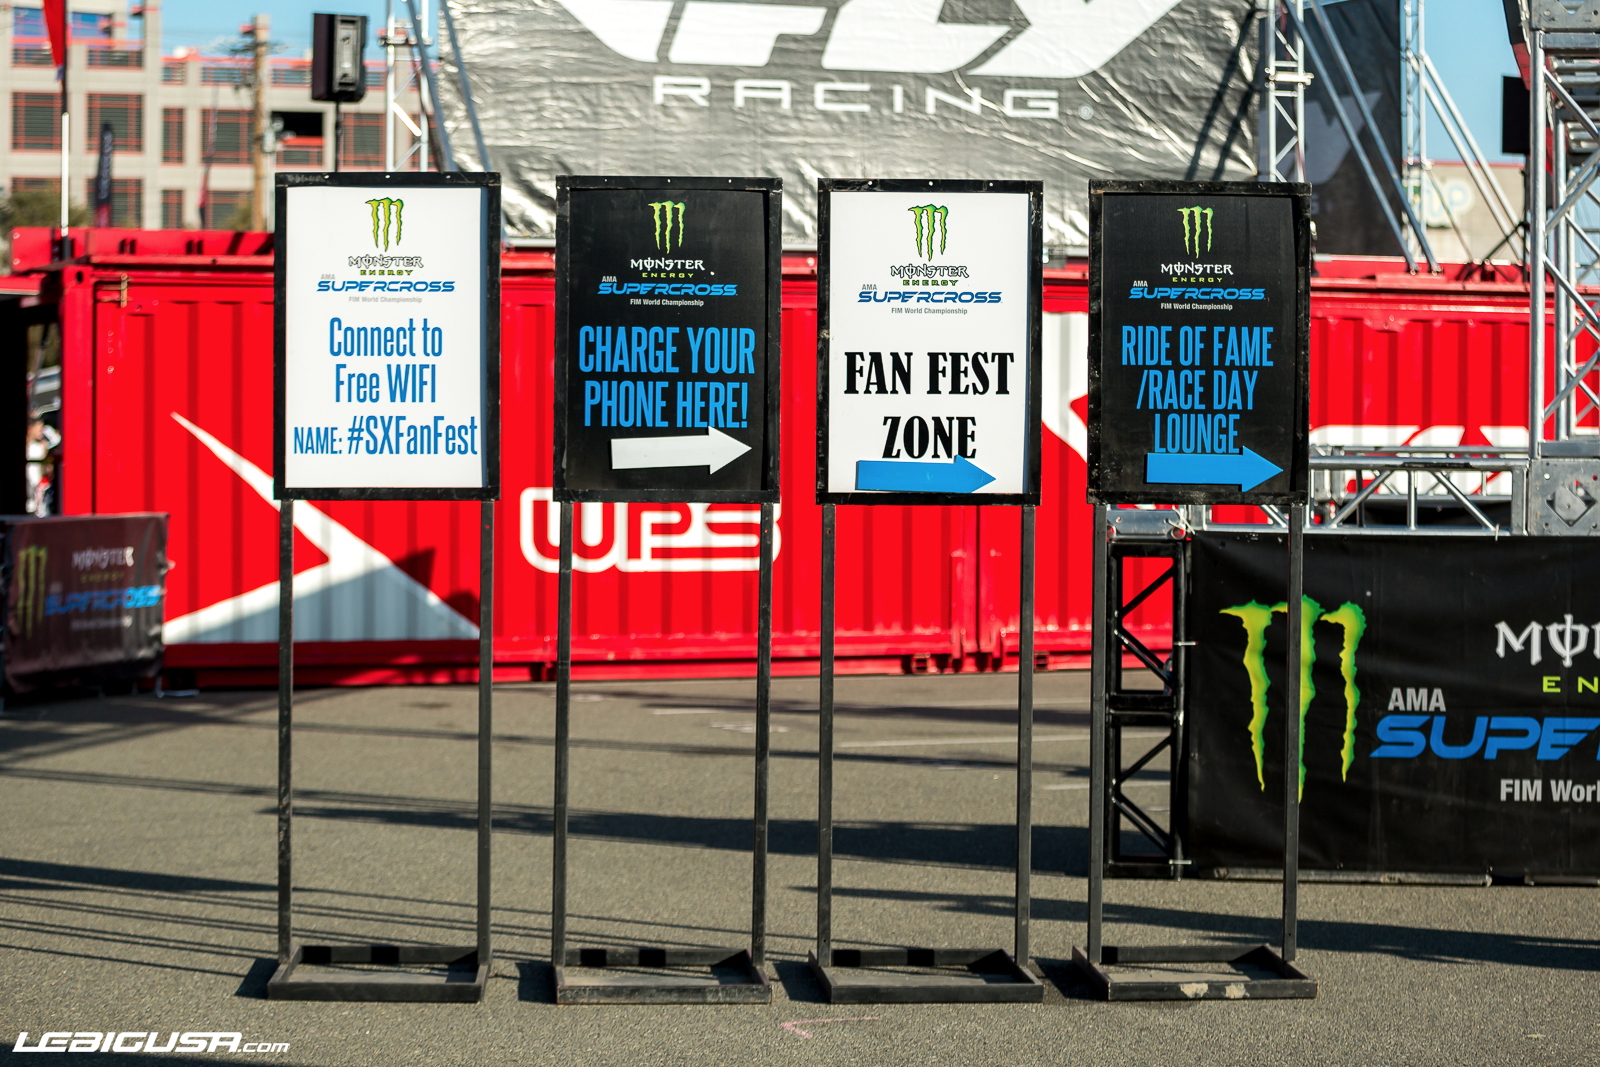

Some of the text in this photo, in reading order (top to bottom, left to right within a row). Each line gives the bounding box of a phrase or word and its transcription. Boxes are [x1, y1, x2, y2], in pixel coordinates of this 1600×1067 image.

[652, 75, 1060, 119] RACING
[348, 254, 424, 269] MONSTER
[630, 257, 705, 271] MONSTER
[890, 263, 970, 279] MONSTER
[1160, 261, 1234, 276] MONSTER
[316, 280, 456, 292] SUPERCROSS
[597, 282, 738, 296] SUPERCROSS
[601, 275, 617, 283] AMA
[380, 296, 423, 304] Championship
[661, 298, 704, 307] Championship
[857, 291, 1002, 304] SUPERCROSS
[1128, 287, 1266, 300] SUPERCROSS
[924, 307, 968, 315] Championship
[1191, 303, 1233, 311] Championship
[329, 317, 443, 357] Connect to
[1121, 325, 1274, 367] RIDE OF FAME
[578, 325, 756, 374] CHARGE YOUR
[335, 363, 437, 403] Free WIFI
[844, 351, 1015, 396] FAN FEST
[1136, 369, 1258, 410] /RACE DAY
[584, 380, 748, 428] PHONE HERE!
[293, 415, 478, 455] NAME: #SXFanFest
[882, 415, 977, 459] ZONE
[1154, 413, 1240, 454] LOUNGE
[1542, 676, 1599, 694] EN
[1387, 687, 1446, 712] AMA
[1368, 714, 1600, 761] SUPE
[1500, 779, 1542, 802] FIM
